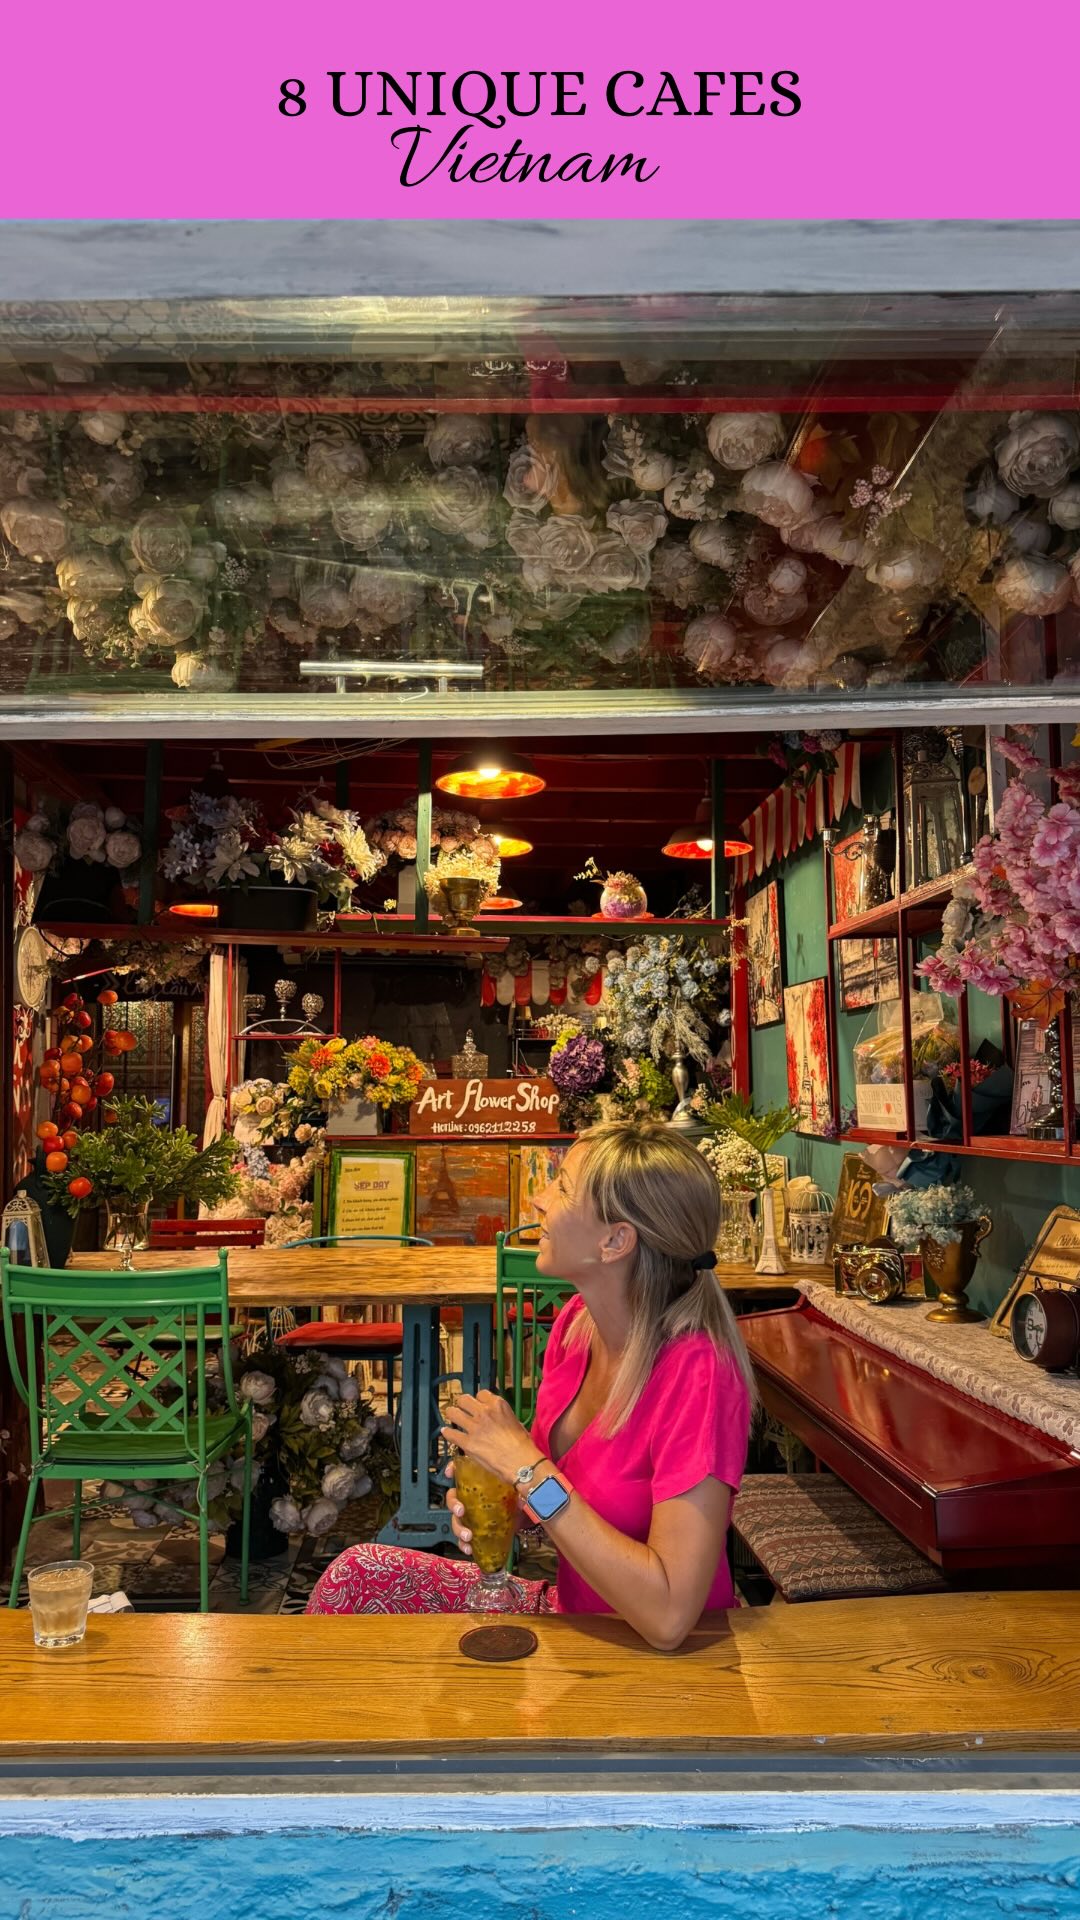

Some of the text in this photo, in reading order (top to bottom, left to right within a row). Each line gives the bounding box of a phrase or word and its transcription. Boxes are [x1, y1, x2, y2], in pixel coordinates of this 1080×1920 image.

[415, 1078, 560, 1118] Art Flower Shop
